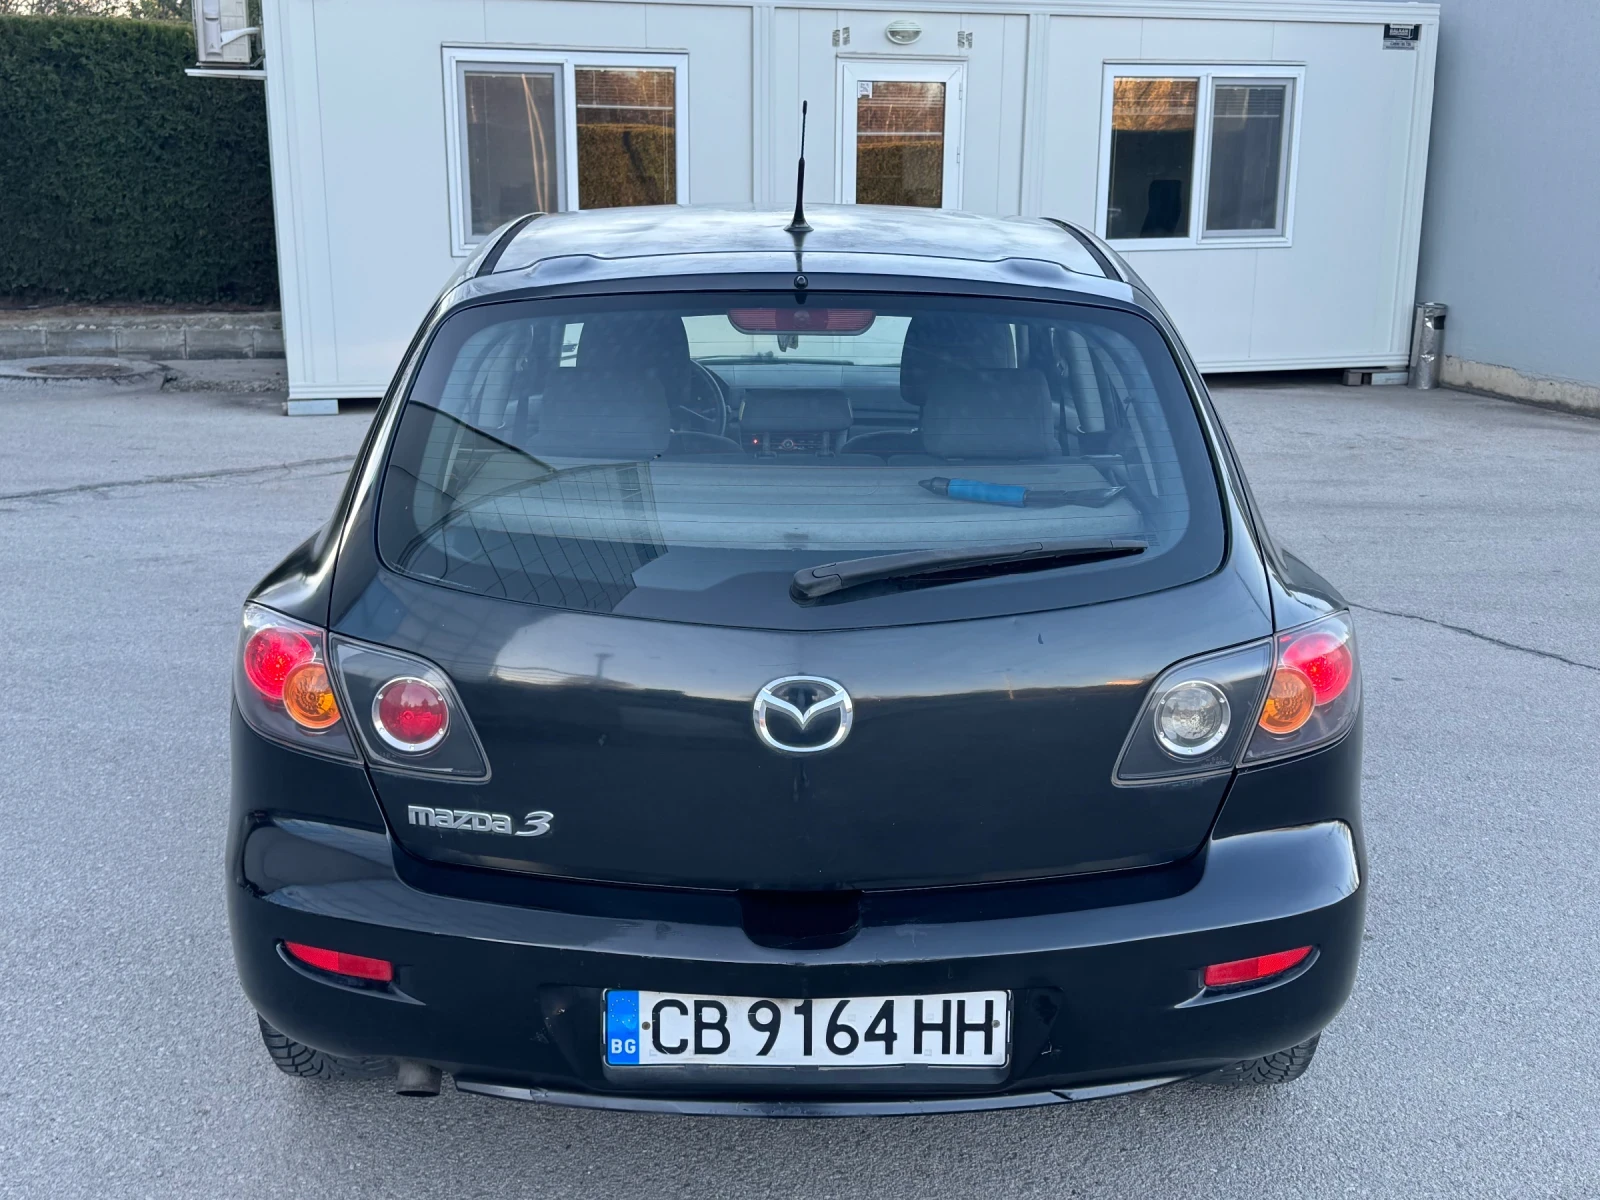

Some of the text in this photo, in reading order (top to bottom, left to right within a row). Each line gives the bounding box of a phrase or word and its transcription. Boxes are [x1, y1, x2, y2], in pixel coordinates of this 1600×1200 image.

[515, 811, 554, 836] 3
[651, 999, 994, 1056] CB 9164 HH
[611, 1038, 636, 1054] BG
